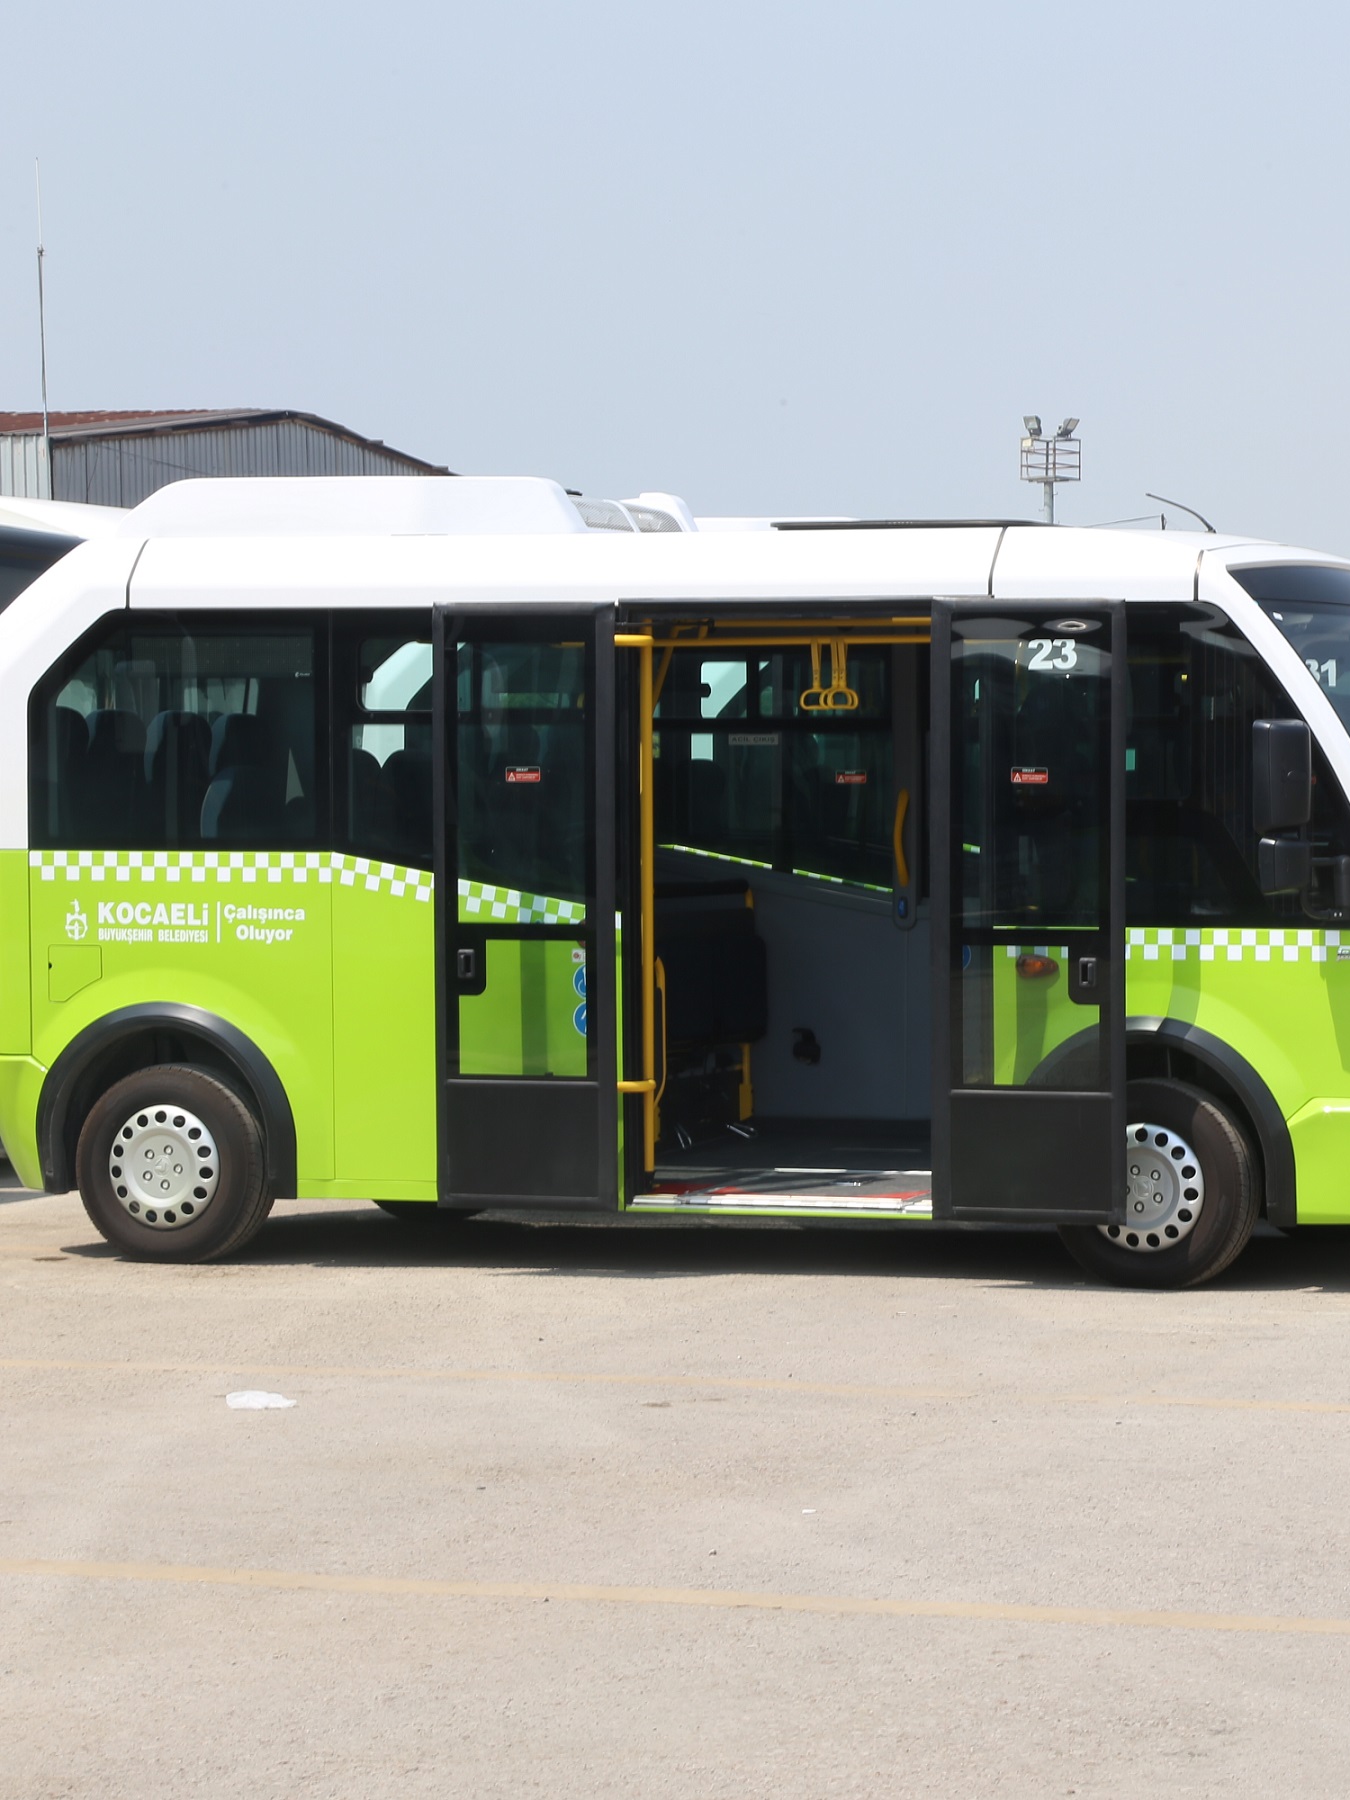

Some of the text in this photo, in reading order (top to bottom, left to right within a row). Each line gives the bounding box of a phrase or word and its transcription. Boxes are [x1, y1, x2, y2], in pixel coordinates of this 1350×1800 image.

[1028, 638, 1077, 670] 23
[223, 903, 305, 924] Çalışınca
[236, 924, 293, 944] Oluyor
